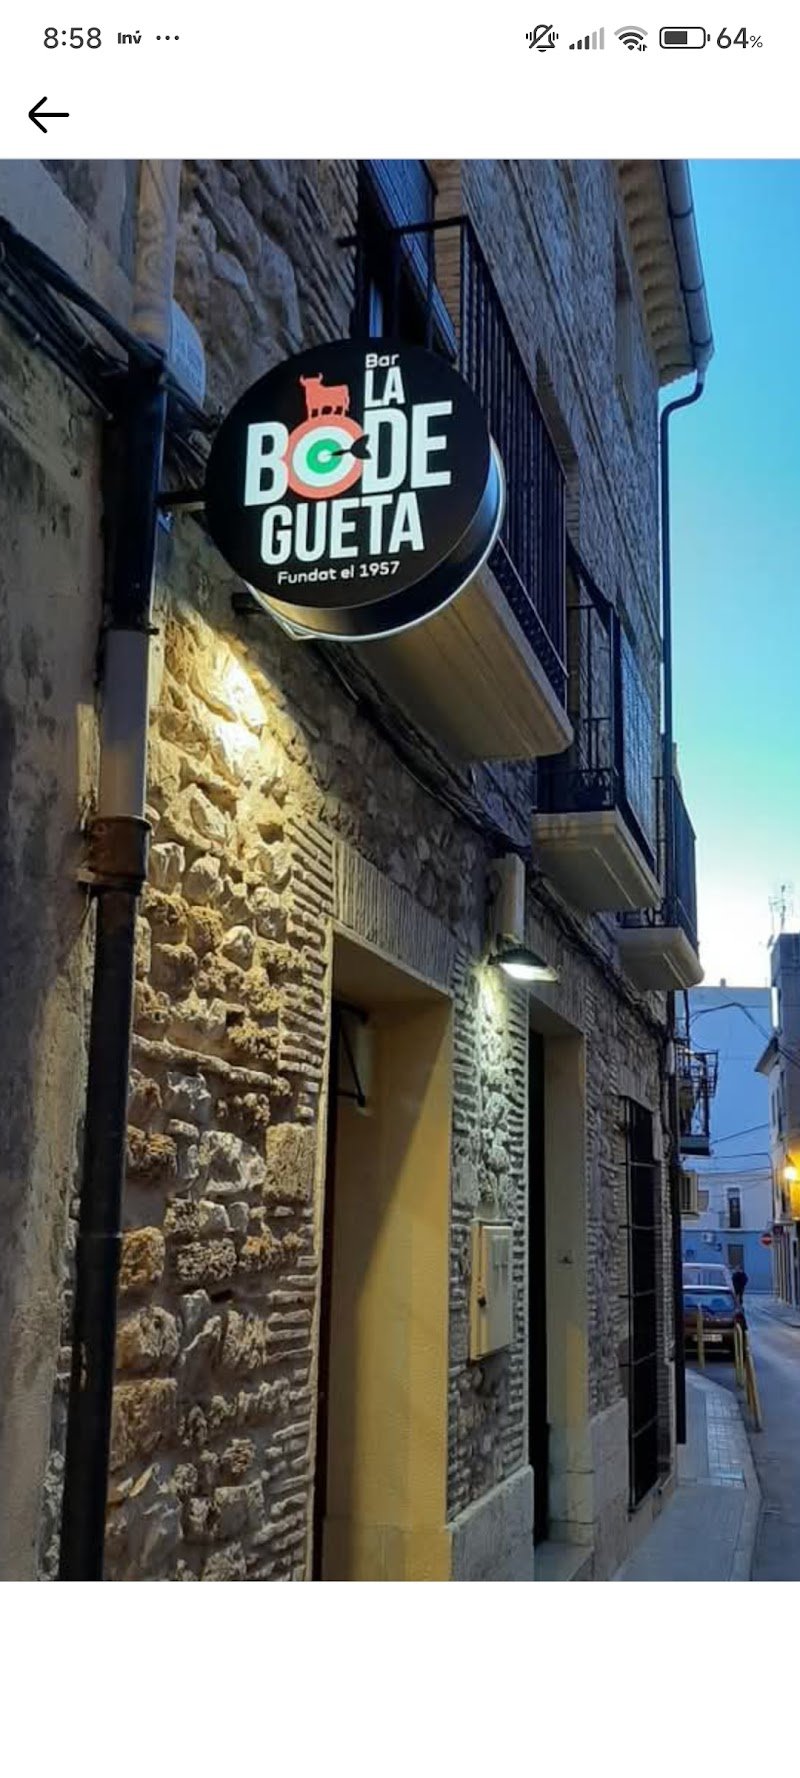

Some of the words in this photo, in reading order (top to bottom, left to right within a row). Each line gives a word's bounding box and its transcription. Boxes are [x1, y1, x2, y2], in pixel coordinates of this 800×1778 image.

[365, 353, 399, 368] Bar
[364, 366, 405, 408] LA
[260, 492, 425, 565] GUETA
[277, 568, 337, 585] Fundat
[340, 566, 354, 580] el
[359, 560, 400, 578] 1957
